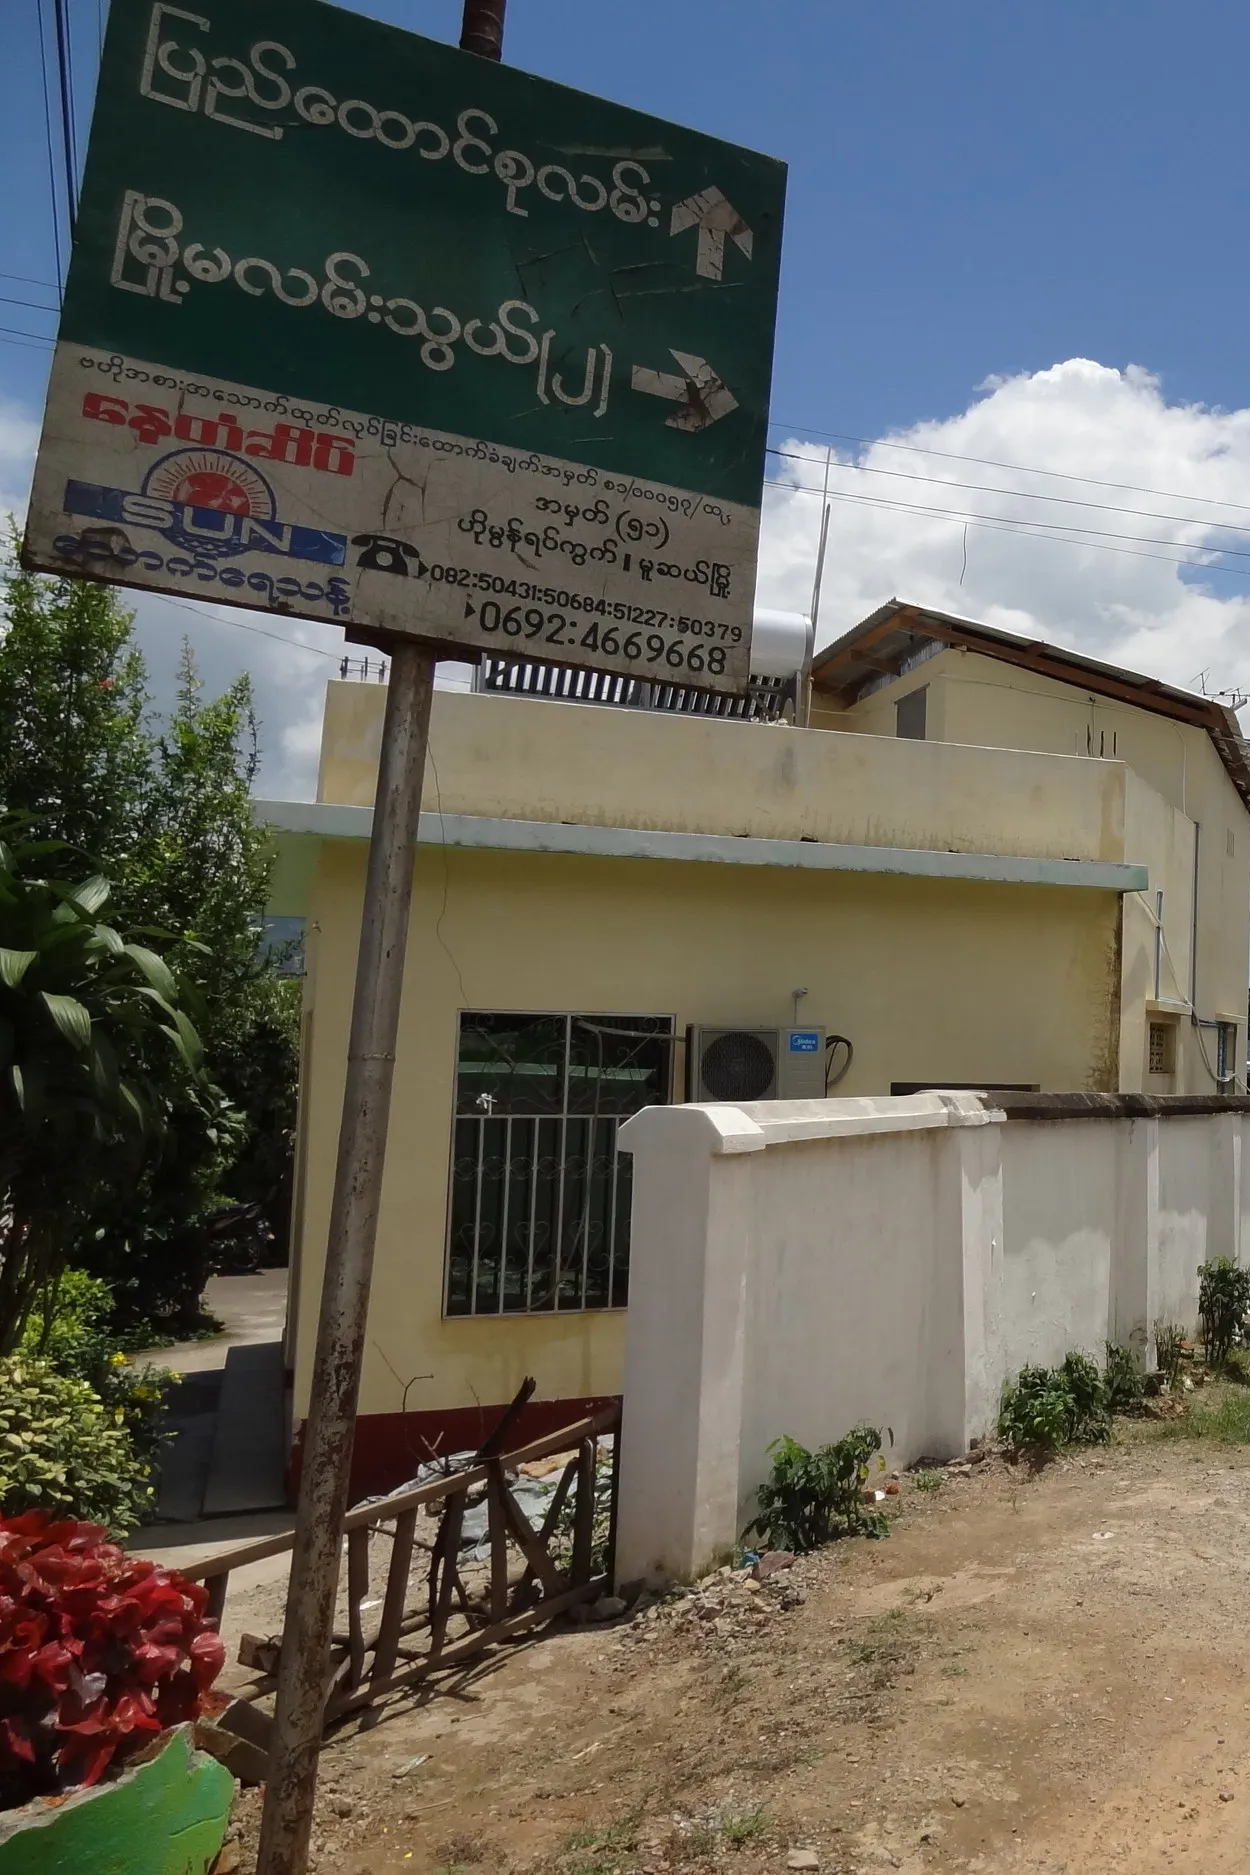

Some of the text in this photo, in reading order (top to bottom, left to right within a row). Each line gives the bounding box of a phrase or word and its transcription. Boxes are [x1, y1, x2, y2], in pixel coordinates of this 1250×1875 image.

[140, 2, 662, 227] ပြည်ထောင်စုလမ်း
[122, 494, 293, 552] SUN
[536, 495, 611, 527] အမှတ်
[479, 600, 727, 676] 0692:4669668
